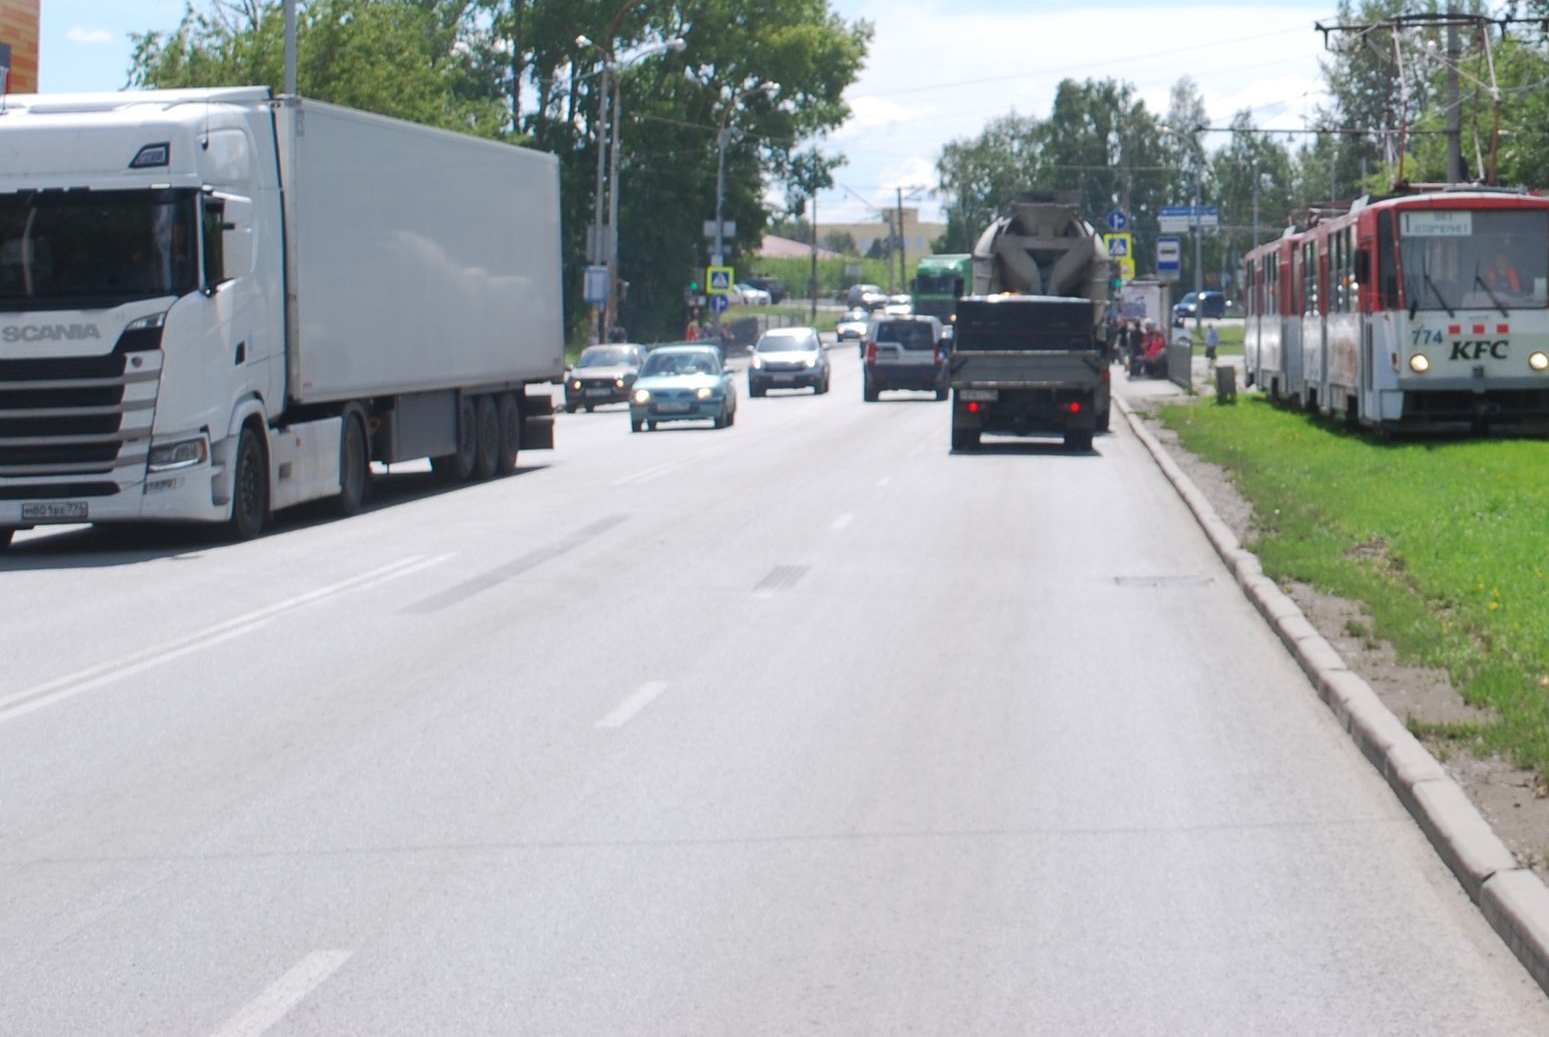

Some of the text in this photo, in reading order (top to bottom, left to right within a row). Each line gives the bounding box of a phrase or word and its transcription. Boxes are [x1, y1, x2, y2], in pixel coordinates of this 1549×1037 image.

[2, 323, 101, 343] SCANIA
[1411, 330, 1443, 345] 774
[1449, 340, 1509, 361] KFC
